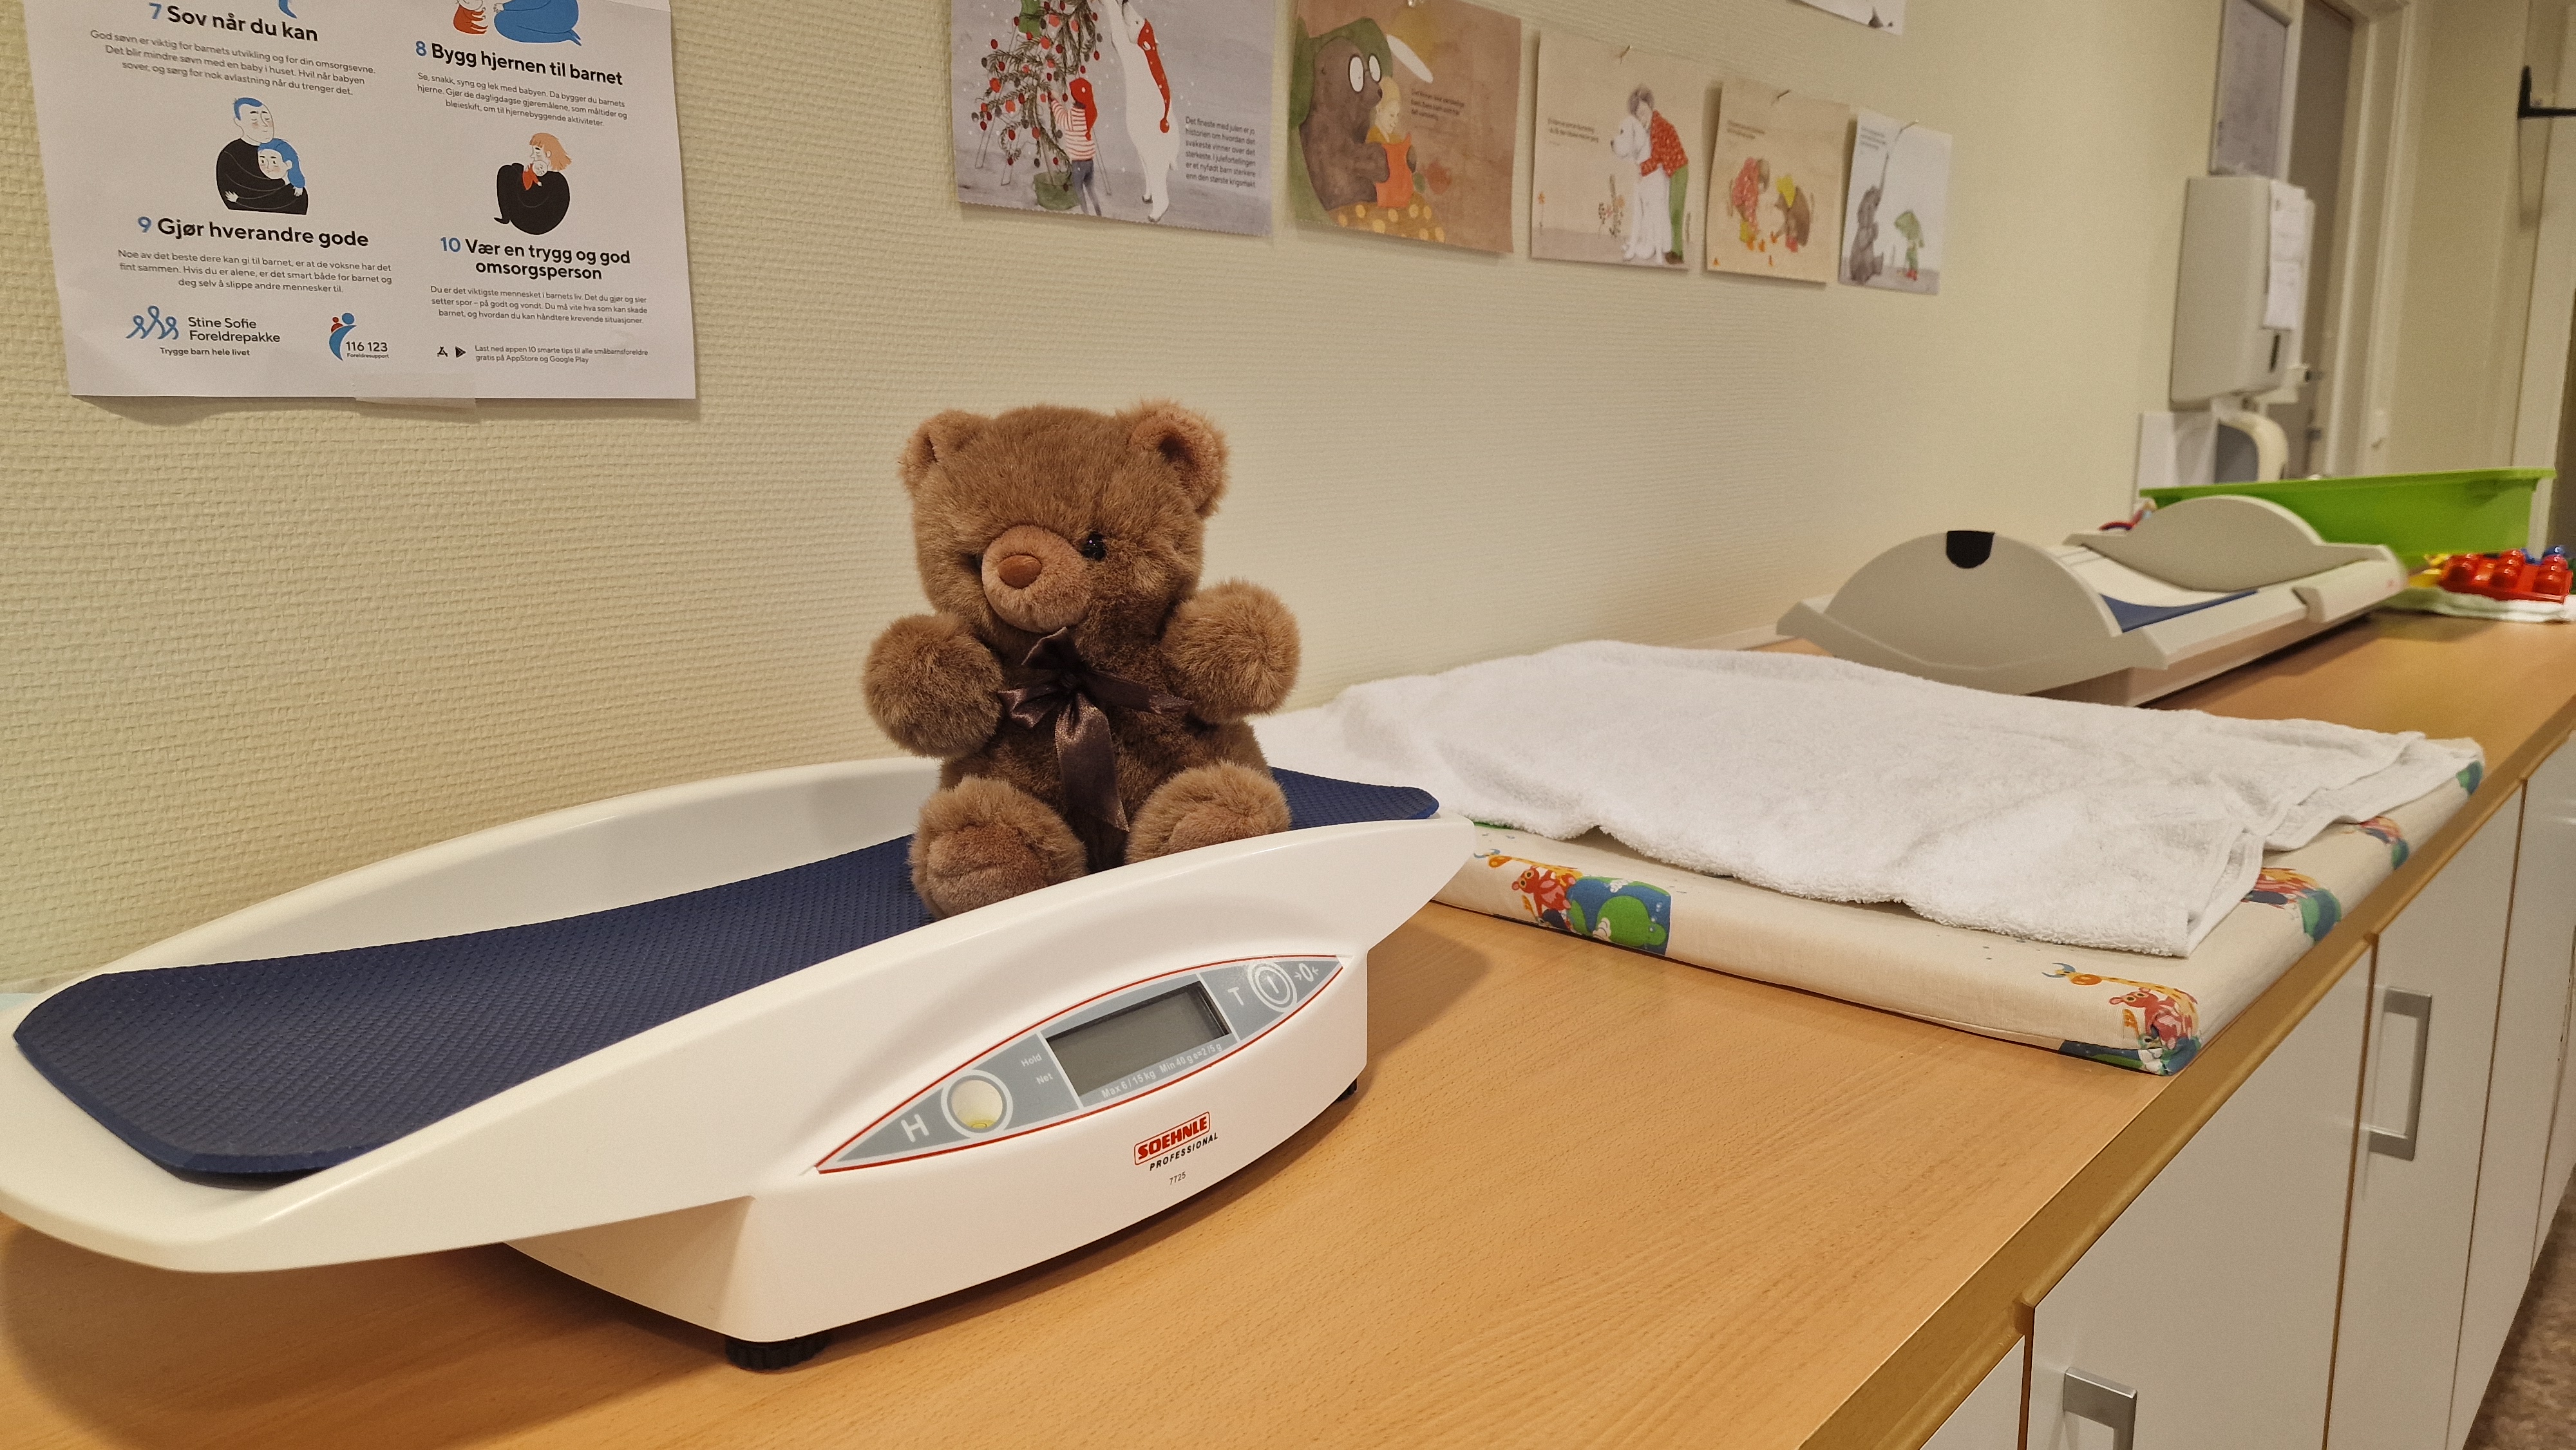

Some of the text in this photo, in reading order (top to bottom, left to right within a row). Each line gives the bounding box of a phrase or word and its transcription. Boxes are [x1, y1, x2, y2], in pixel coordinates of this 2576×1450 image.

[149, 3, 317, 41] 7 Sov når du kan
[90, 30, 112, 40] God
[114, 34, 137, 43] søvn
[150, 38, 177, 50] viktig
[178, 41, 192, 50] for
[194, 43, 230, 55] barnets
[231, 50, 270, 62] utvikling
[272, 55, 283, 64] og
[285, 55, 298, 63] for
[299, 57, 314, 66] din
[315, 61, 375, 73] omsorgsevne.
[416, 41, 622, 85] 8 Bygg hjernen til barnet
[417, 71, 430, 81] Se,
[431, 75, 455, 84] snakk,
[457, 79, 475, 88] syng
[488, 82, 498, 90] lek
[518, 86, 547, 97] babyen.
[549, 90, 560, 99] Da
[561, 92, 586, 102] bygger
[598, 97, 625, 107] barnets
[417, 84, 444, 94] hjerne.
[446, 88, 462, 97] Gjør
[475, 92, 521, 105] dagligdagse
[522, 99, 569, 111] gjøremålene,
[587, 107, 616, 117] måltider
[446, 99, 482, 111] bleieskift,
[506, 107, 566, 121] hjernebyggende
[567, 116, 603, 126] aktiviteter.
[137, 216, 368, 248] 9 Gjør hverandre gode
[118, 249, 138, 258] Noe
[171, 252, 198, 261] beste
[200, 254, 221, 262] dere
[241, 256, 249, 265] gi
[261, 257, 293, 267] barnet,
[440, 236, 629, 266] 10 Vær en trygg og god
[475, 262, 601, 280] omsorgsperson
[178, 278, 196, 288] deg
[218, 279, 223, 287] å
[225, 280, 252, 290] slippe
[467, 288, 498, 297] viktigste
[188, 316, 256, 328] Stine Sofie
[439, 308, 466, 317] barnet,
[604, 316, 643, 325] situasjoner.
[189, 330, 279, 344] Foreldrepakke
[346, 341, 388, 352] 116 123
[160, 347, 189, 356] Trygge
[1227, 986, 1244, 1006] T
[1021, 1053, 1042, 1067] Hold
[1036, 1073, 1053, 1084] Net
[1101, 1086, 1121, 1098] Max
[1121, 1080, 1128, 1089] 6
[1132, 1075, 1144, 1084] 15
[1144, 1070, 1156, 1081] kg
[1159, 1062, 1175, 1073] Min
[1176, 1057, 1186, 1066] 40
[1187, 1055, 1192, 1064] g
[1216, 1043, 1222, 1052] g
[900, 1113, 929, 1142] H
[1137, 1116, 1208, 1160] SOEHNLE
[1150, 1132, 1218, 1171] PROFESSIONAL
[1170, 1171, 1186, 1185] 7725
